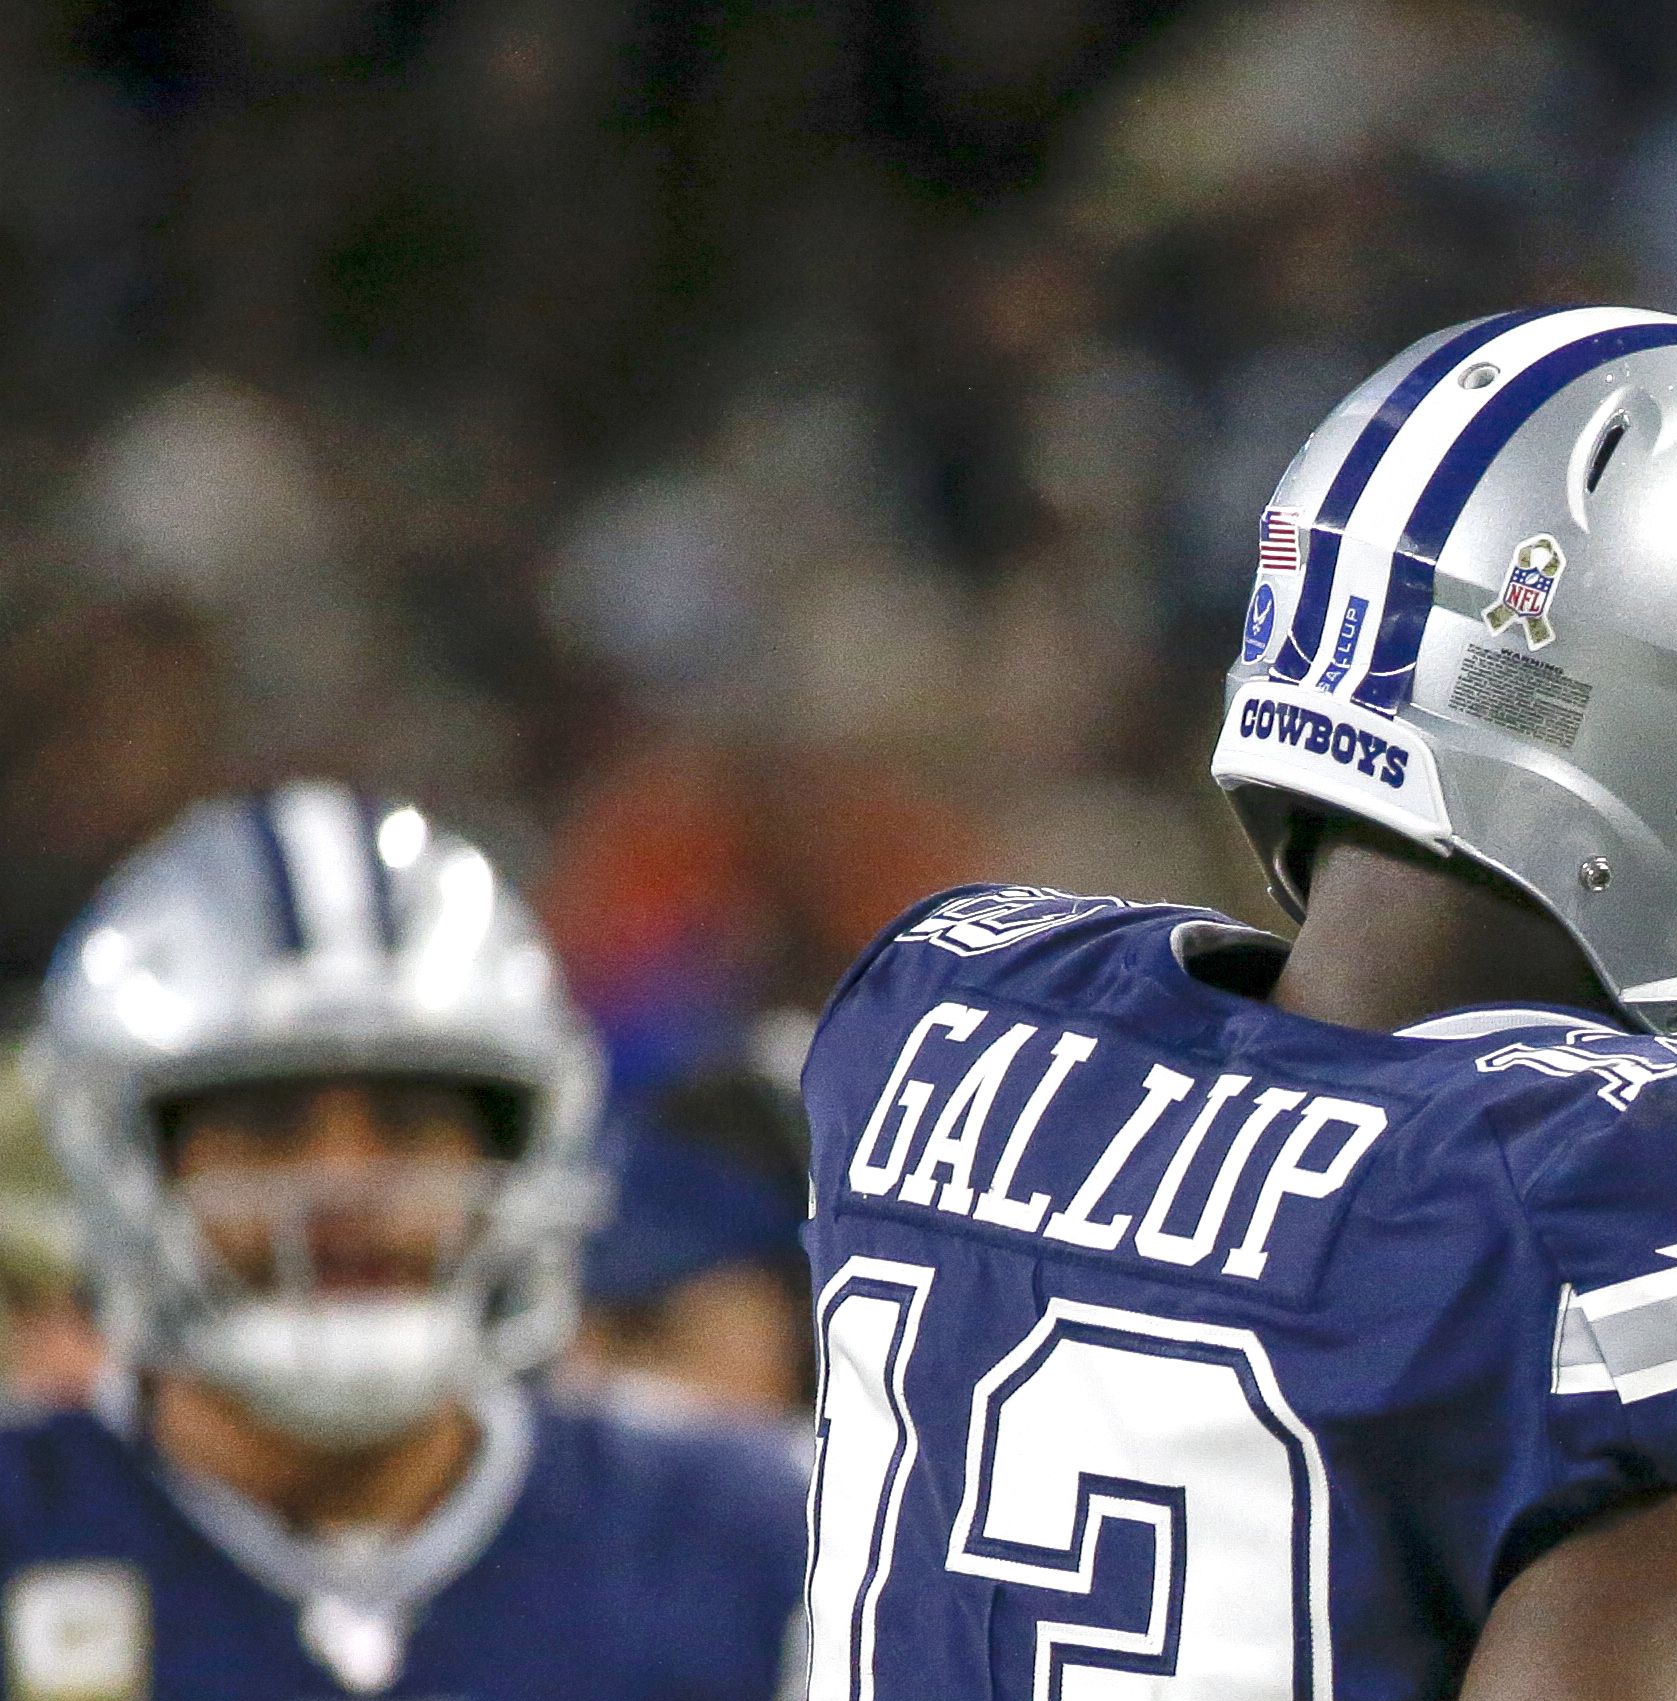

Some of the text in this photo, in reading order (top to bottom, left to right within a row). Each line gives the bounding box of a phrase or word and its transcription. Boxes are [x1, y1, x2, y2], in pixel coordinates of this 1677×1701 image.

[1507, 583, 1541, 613] NFL
[1239, 698, 1409, 789] COWBOYS
[848, 1001, 1387, 1283] GALLUP
